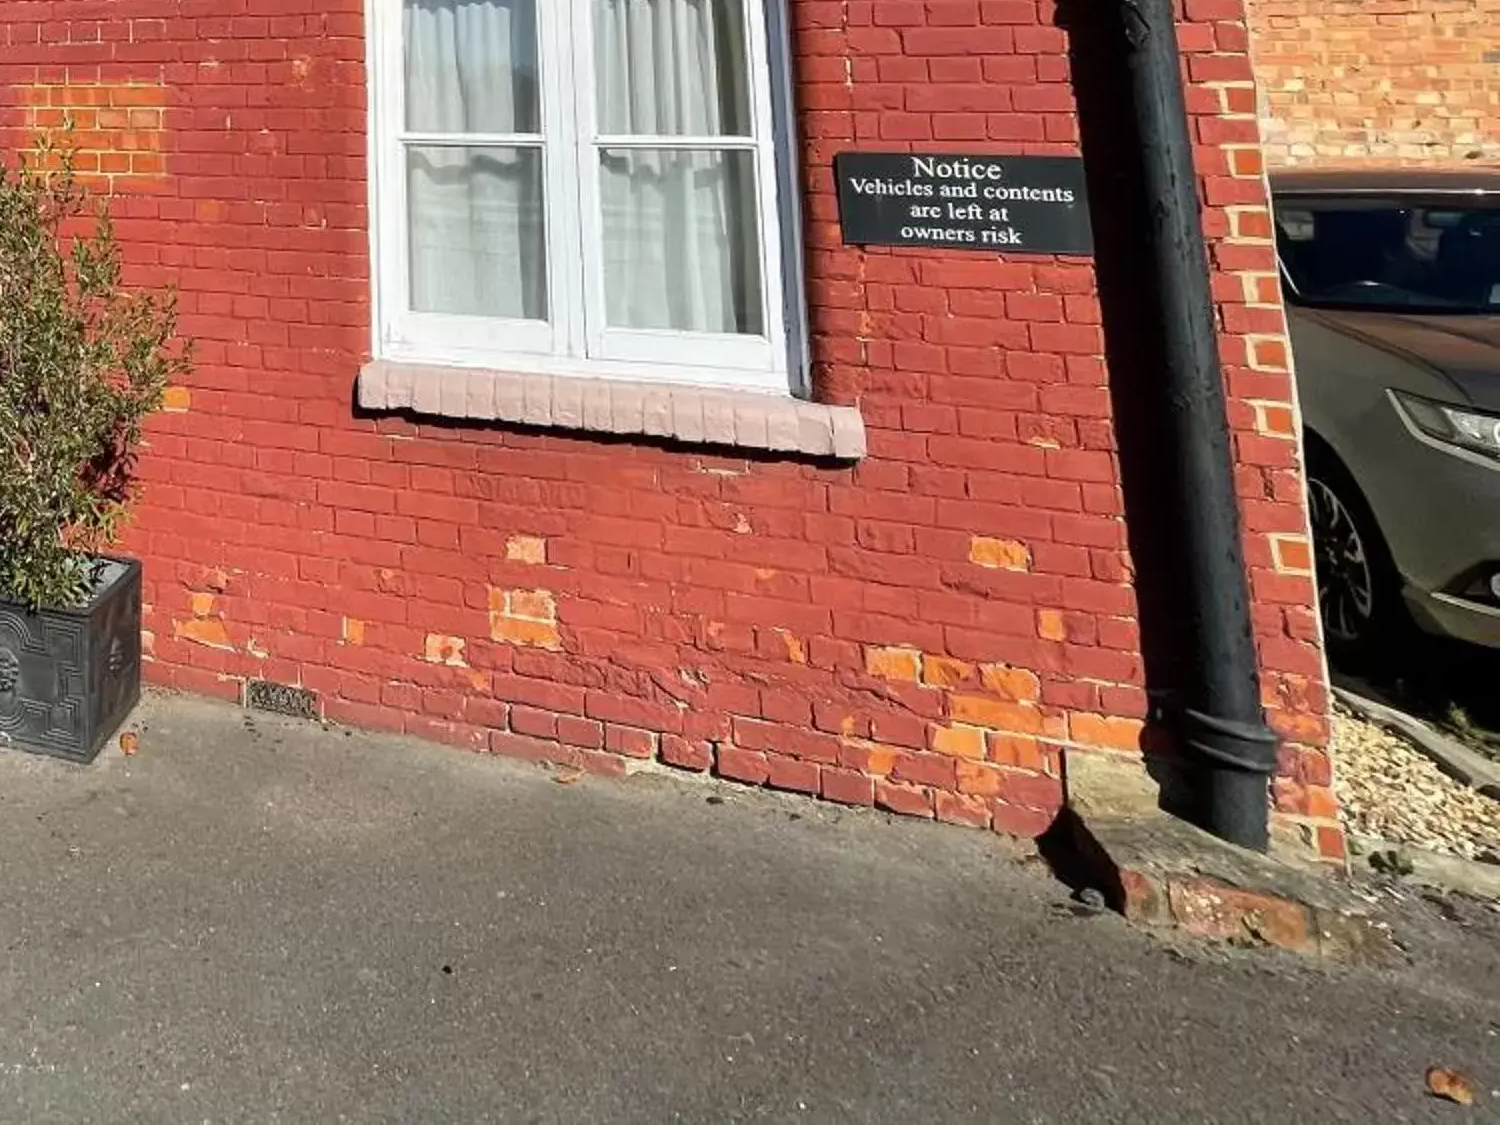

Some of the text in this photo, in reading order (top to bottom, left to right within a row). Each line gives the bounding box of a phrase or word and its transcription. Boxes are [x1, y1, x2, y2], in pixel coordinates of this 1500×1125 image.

[911, 157, 1002, 180] Notice
[850, 178, 1075, 202] Vehicles and contents
[910, 203, 1009, 222] are left at
[901, 226, 1022, 245] owners risk
